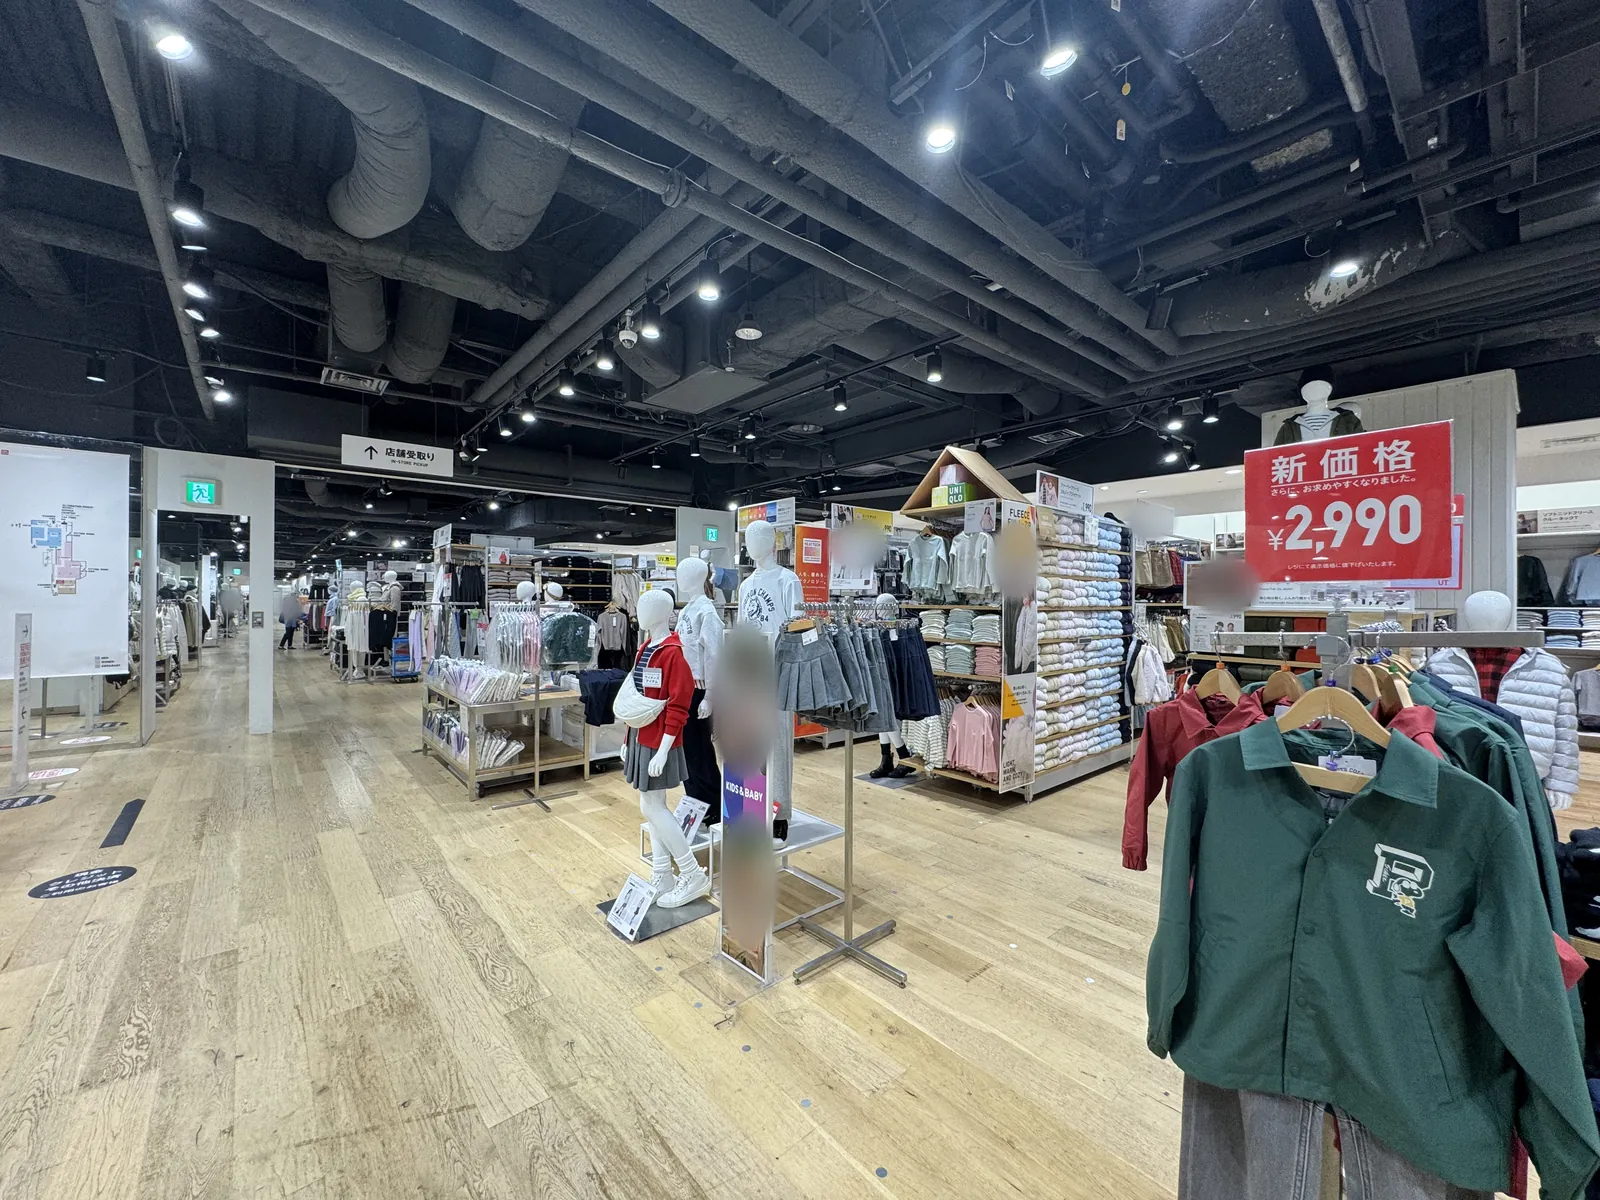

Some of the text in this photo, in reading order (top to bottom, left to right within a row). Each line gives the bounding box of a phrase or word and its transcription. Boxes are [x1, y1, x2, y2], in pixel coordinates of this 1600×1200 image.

[385, 448, 434, 461] 店舗受取り
[1271, 439, 1416, 485] 新価格
[949, 486, 962, 495] UNI
[1270, 474, 1417, 497] さらに、お求めやすくなりました。
[948, 494, 962, 504] QLO
[1009, 508, 1030, 519] FLEECE
[1267, 494, 1422, 554] ¥2,990
[757, 587, 776, 613] CHAMPS
[725, 780, 764, 803] KIDS & BABY
